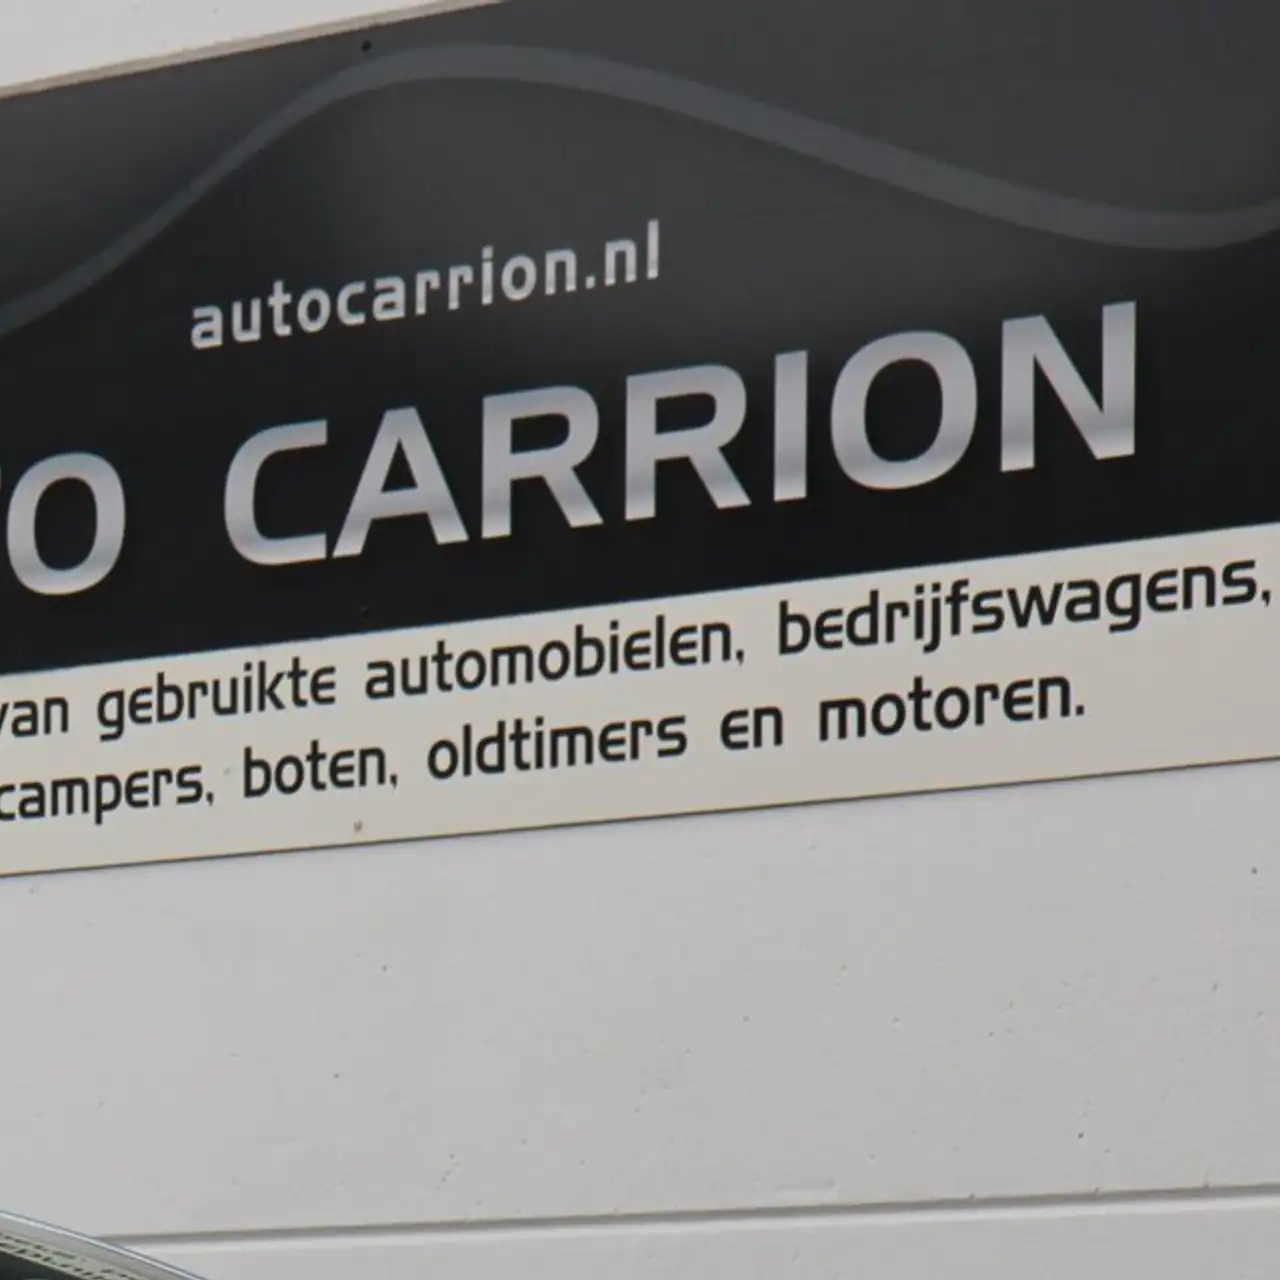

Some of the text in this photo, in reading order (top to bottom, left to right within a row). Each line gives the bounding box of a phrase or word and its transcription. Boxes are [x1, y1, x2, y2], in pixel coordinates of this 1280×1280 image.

[190, 217, 661, 351] autocarrion.nl
[223, 300, 1138, 567] CARRION
[96, 654, 338, 743] gebruikte
[364, 613, 746, 702] automobielen,
[777, 558, 1273, 656] bedrijfswagens,
[243, 745, 399, 799] boten,
[426, 714, 689, 782] oldtimers
[719, 705, 785, 751] en
[818, 672, 1087, 743] motoren.
